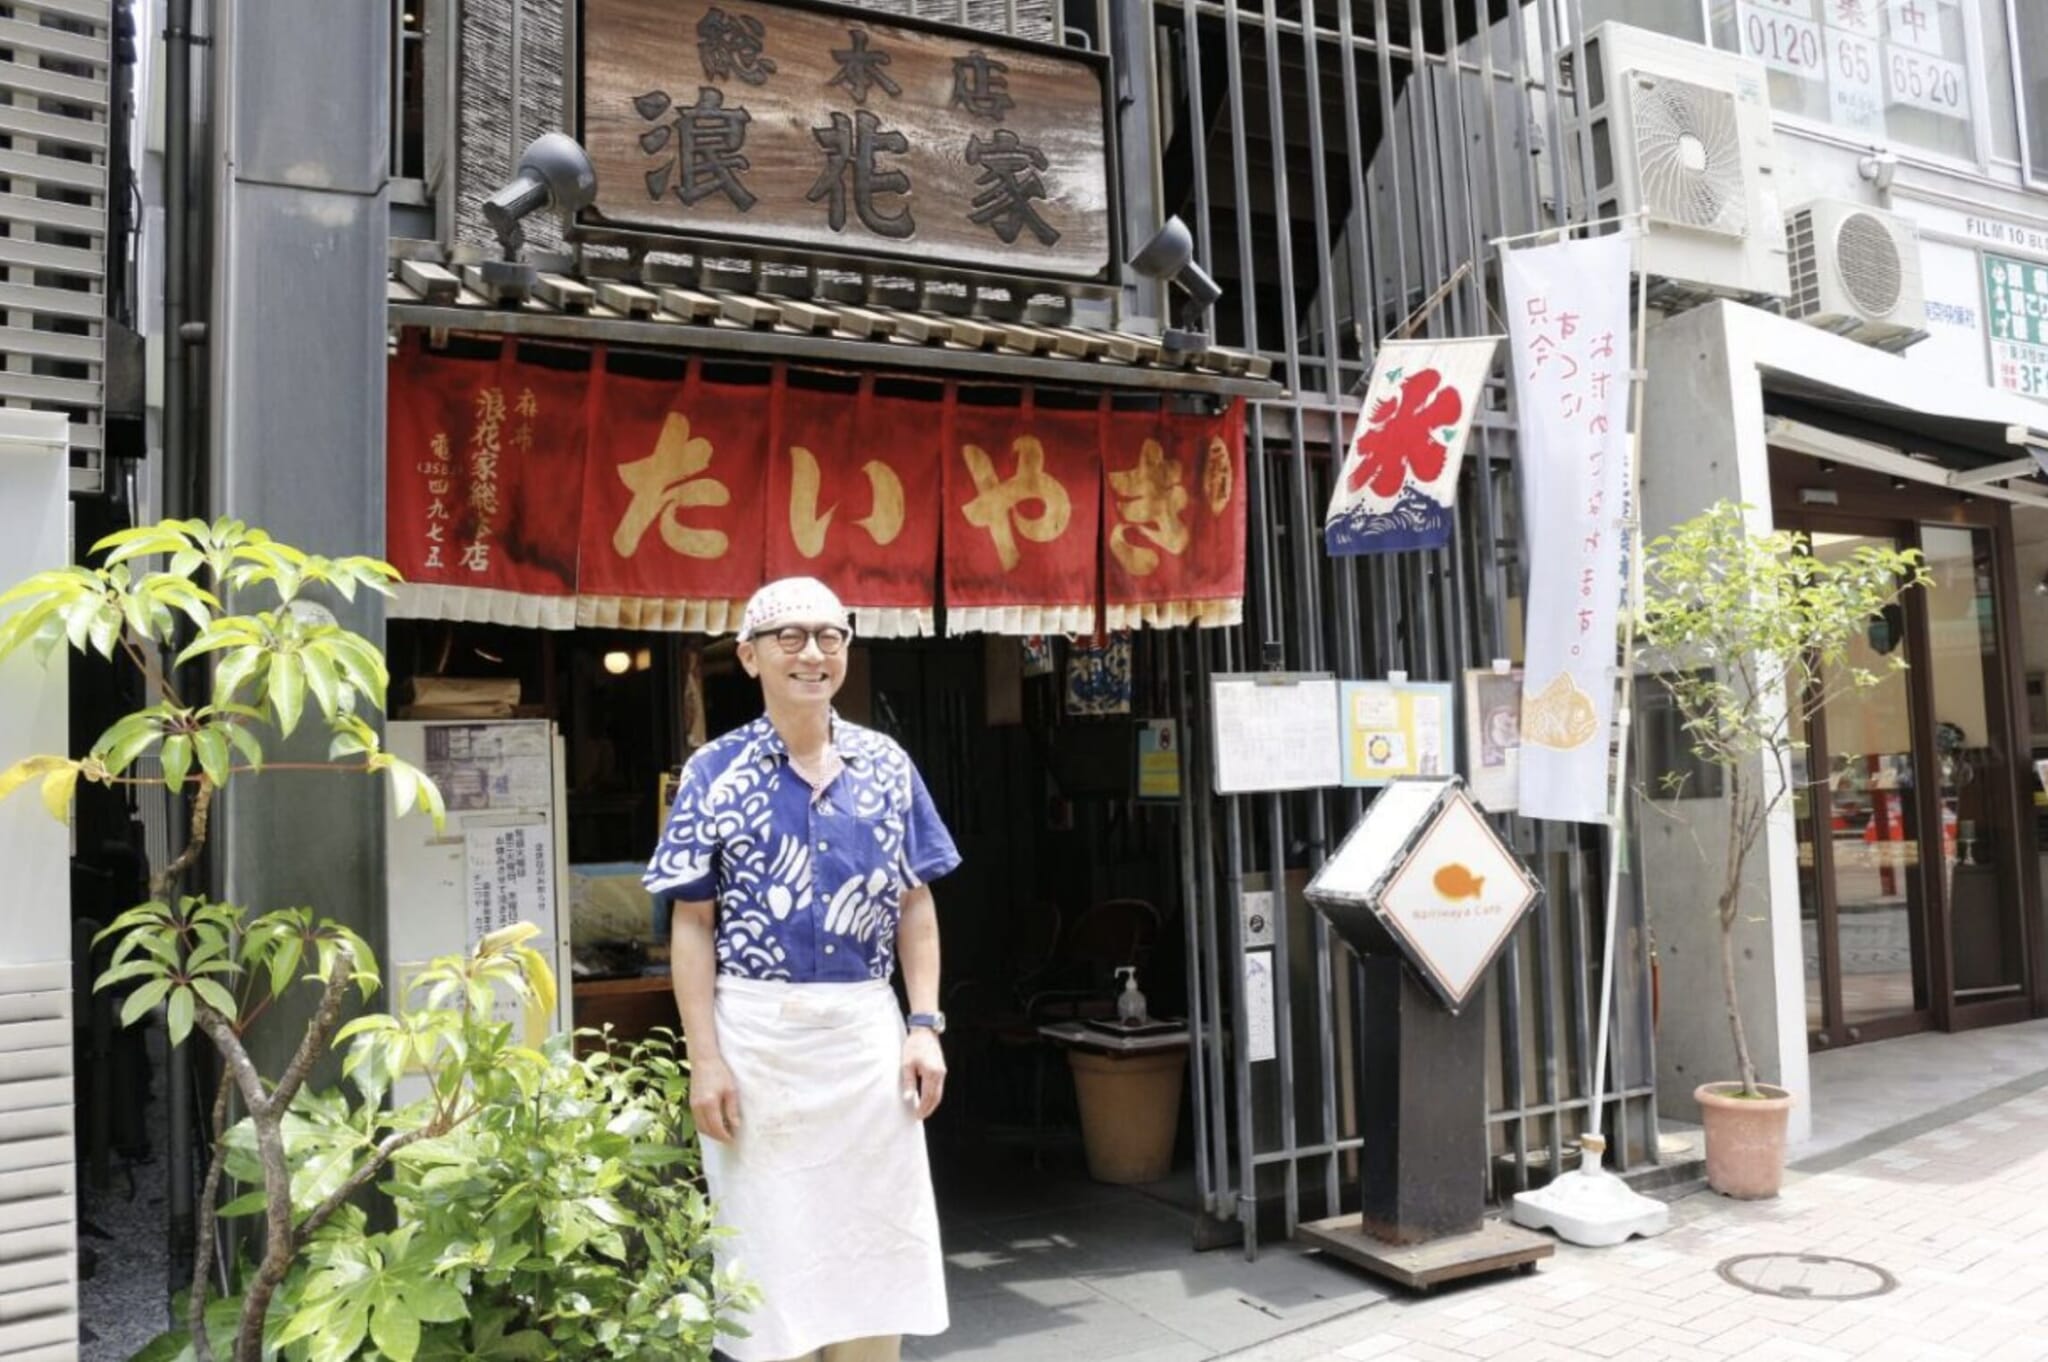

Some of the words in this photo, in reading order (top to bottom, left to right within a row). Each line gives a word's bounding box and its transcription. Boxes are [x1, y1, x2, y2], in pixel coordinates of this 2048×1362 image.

[695, 7, 1017, 122] 総本店
[1748, 13, 1818, 69] 0120
[1838, 38, 1871, 85] 65
[633, 87, 1061, 248] 浪花家
[1965, 218, 2004, 242] FILM
[2008, 227, 2025, 245] 10
[612, 411, 1190, 576] たいやき
[1347, 367, 1464, 499] 氷
